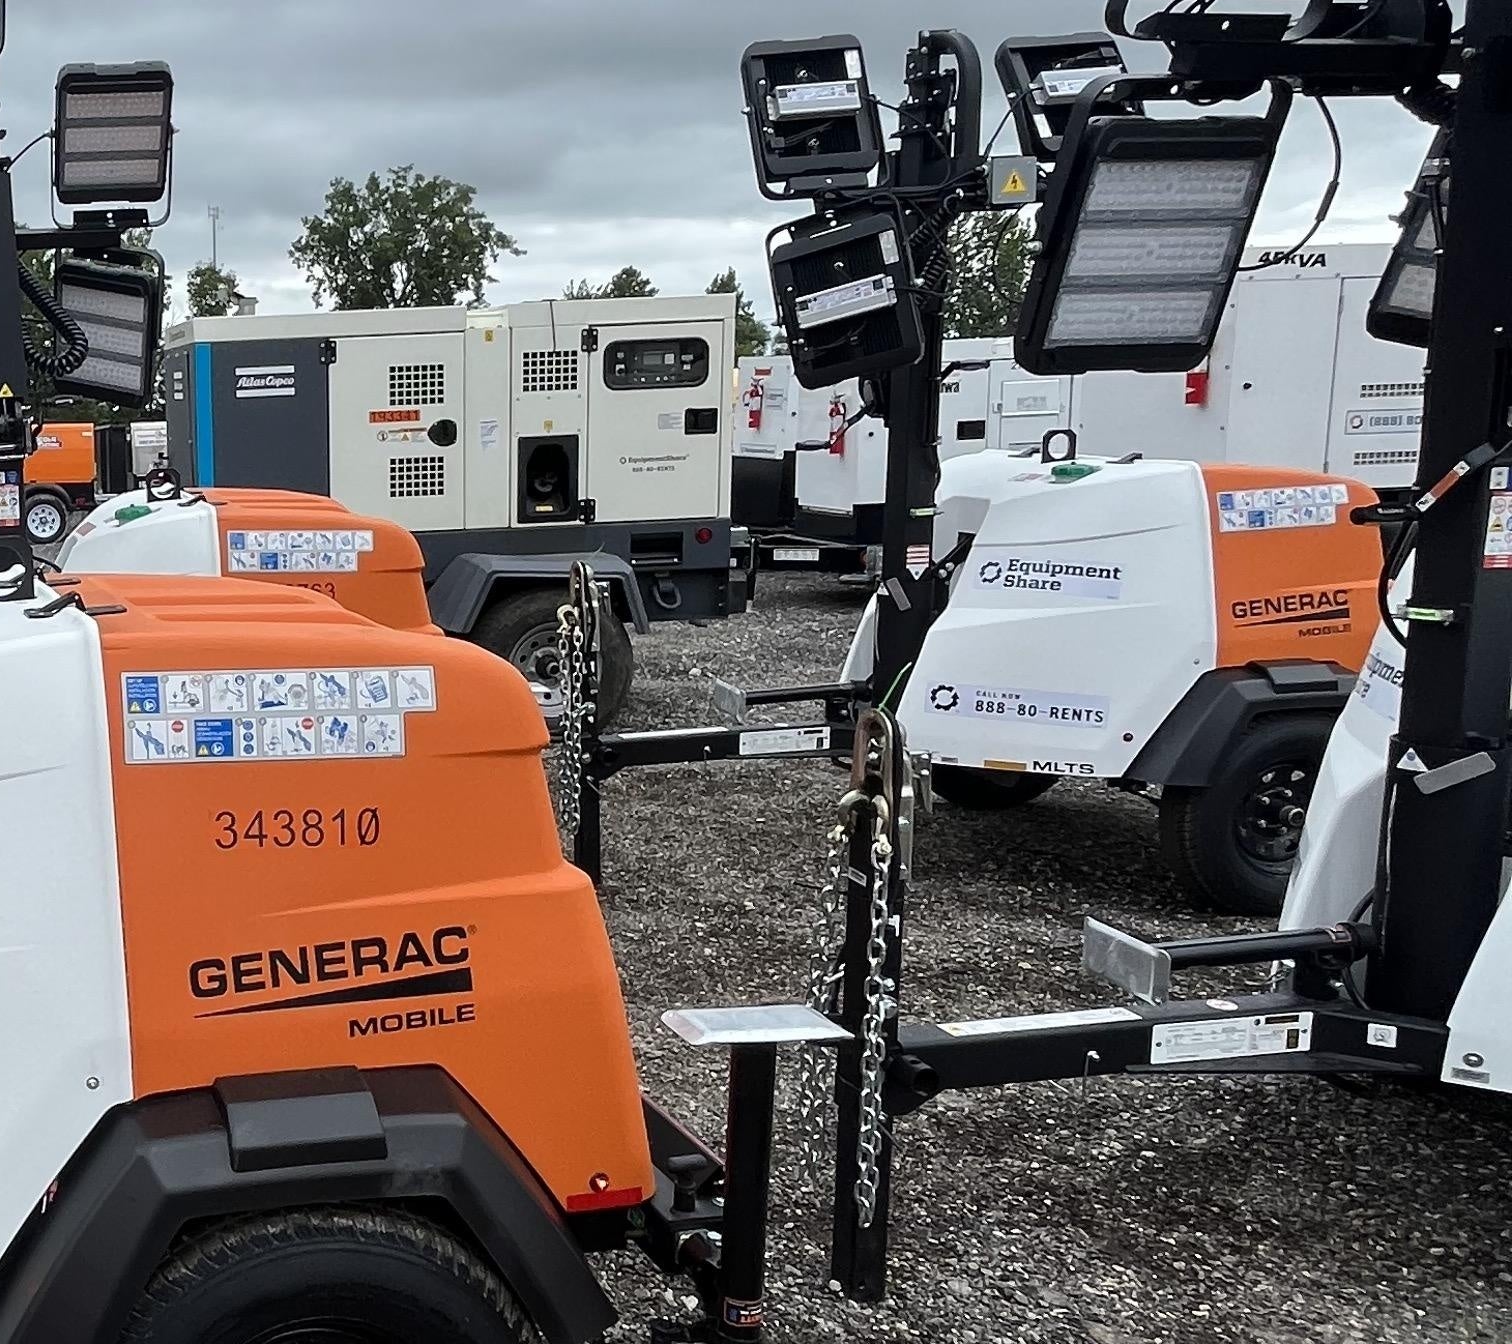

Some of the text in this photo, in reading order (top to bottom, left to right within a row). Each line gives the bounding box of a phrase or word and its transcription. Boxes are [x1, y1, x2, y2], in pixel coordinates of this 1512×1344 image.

[236, 375, 295, 388] Atlas Copco
[1006, 558, 1123, 581] Equipment
[1002, 574, 1062, 592] Share
[1231, 589, 1349, 619] GENERAC
[1298, 623, 1352, 638] MOBILE
[975, 700, 1105, 723] 888-80-RENTS
[1032, 760, 1095, 775] MLTS
[214, 807, 380, 849] 343810
[189, 925, 470, 998] GENERAC
[348, 1003, 476, 1038] MOBILE
